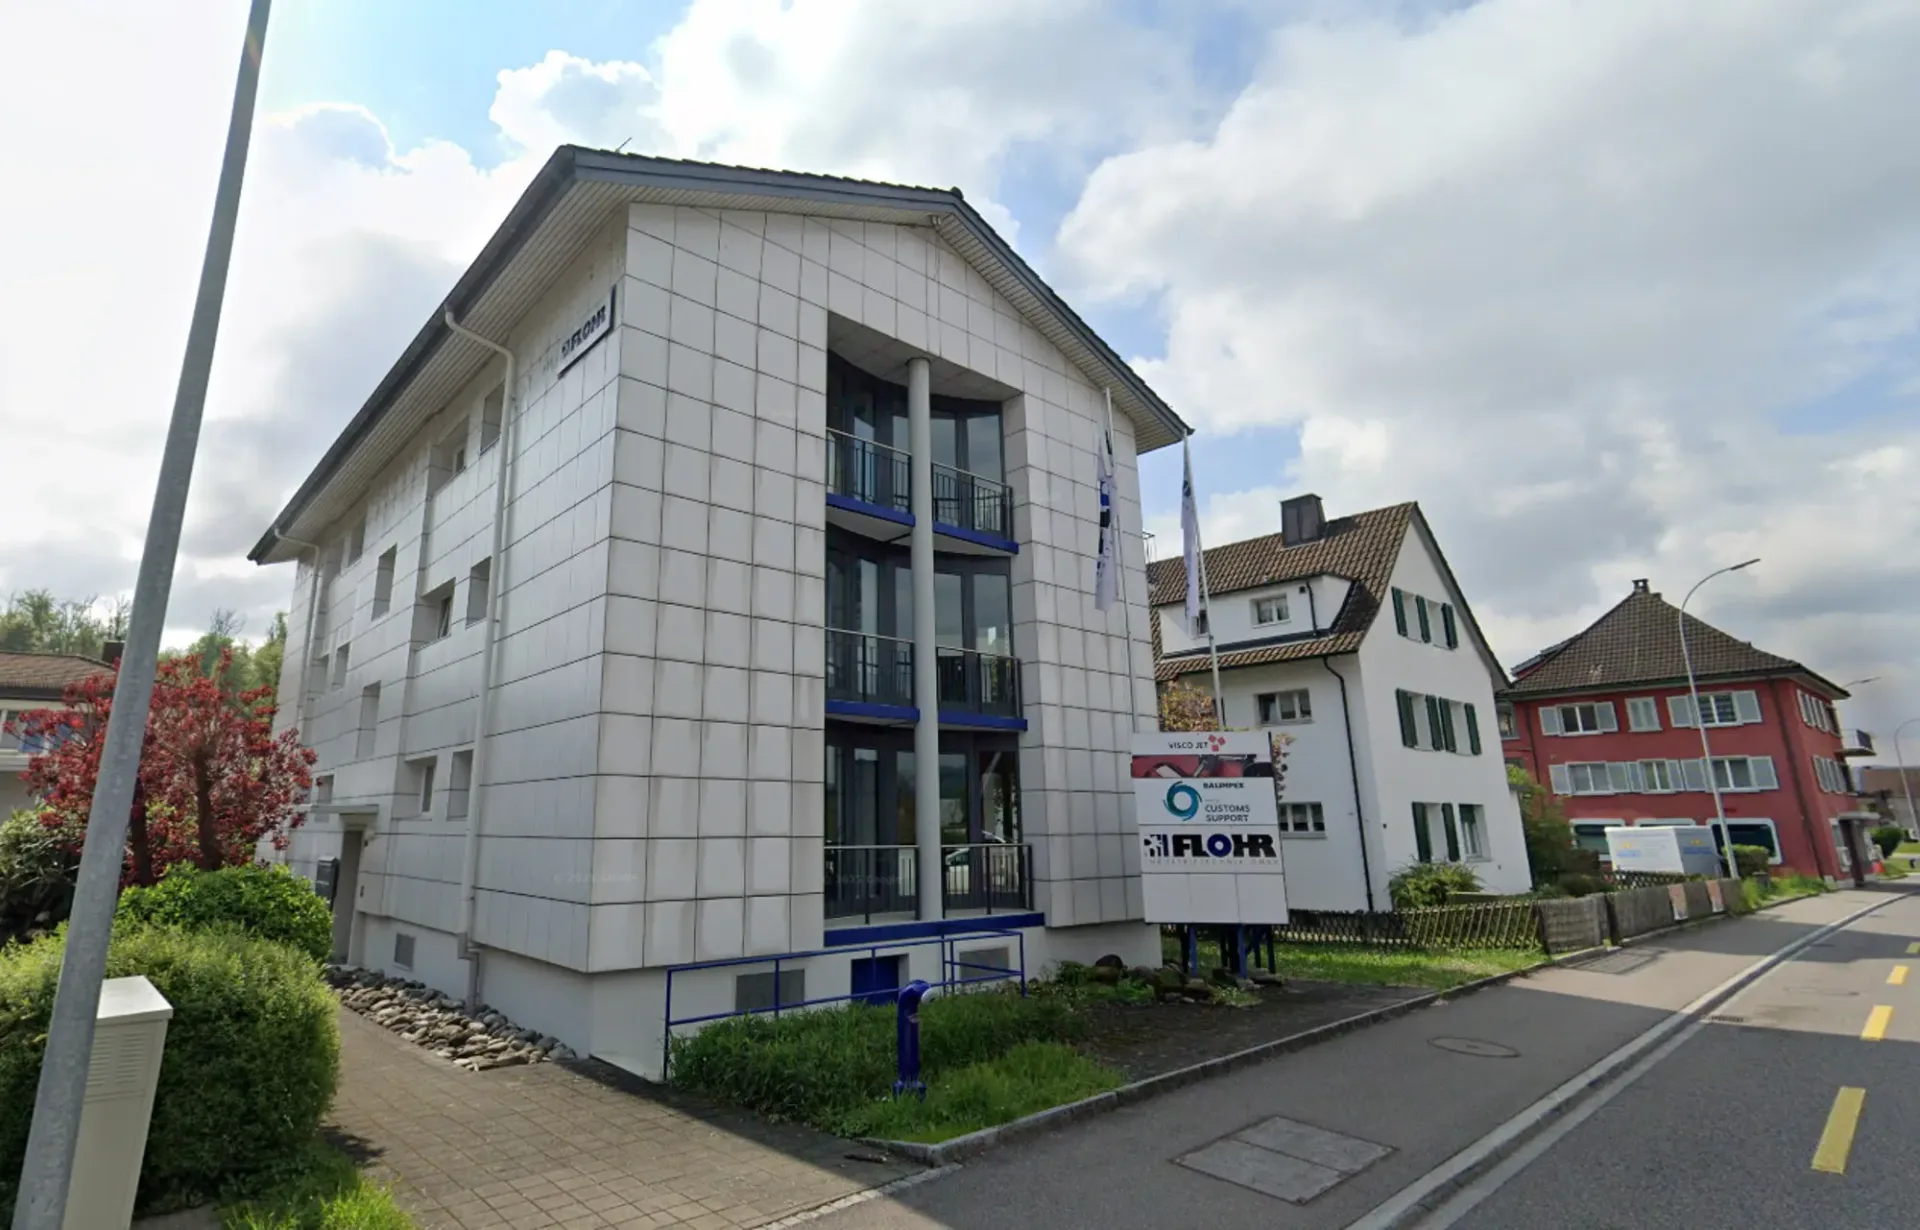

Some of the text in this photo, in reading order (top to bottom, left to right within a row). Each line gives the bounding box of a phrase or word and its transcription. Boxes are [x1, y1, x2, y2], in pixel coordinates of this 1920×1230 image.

[1205, 804, 1250, 813] CUSTOMS
[1206, 814, 1249, 822] SUPPORT
[1172, 833, 1277, 858] FLOHR
